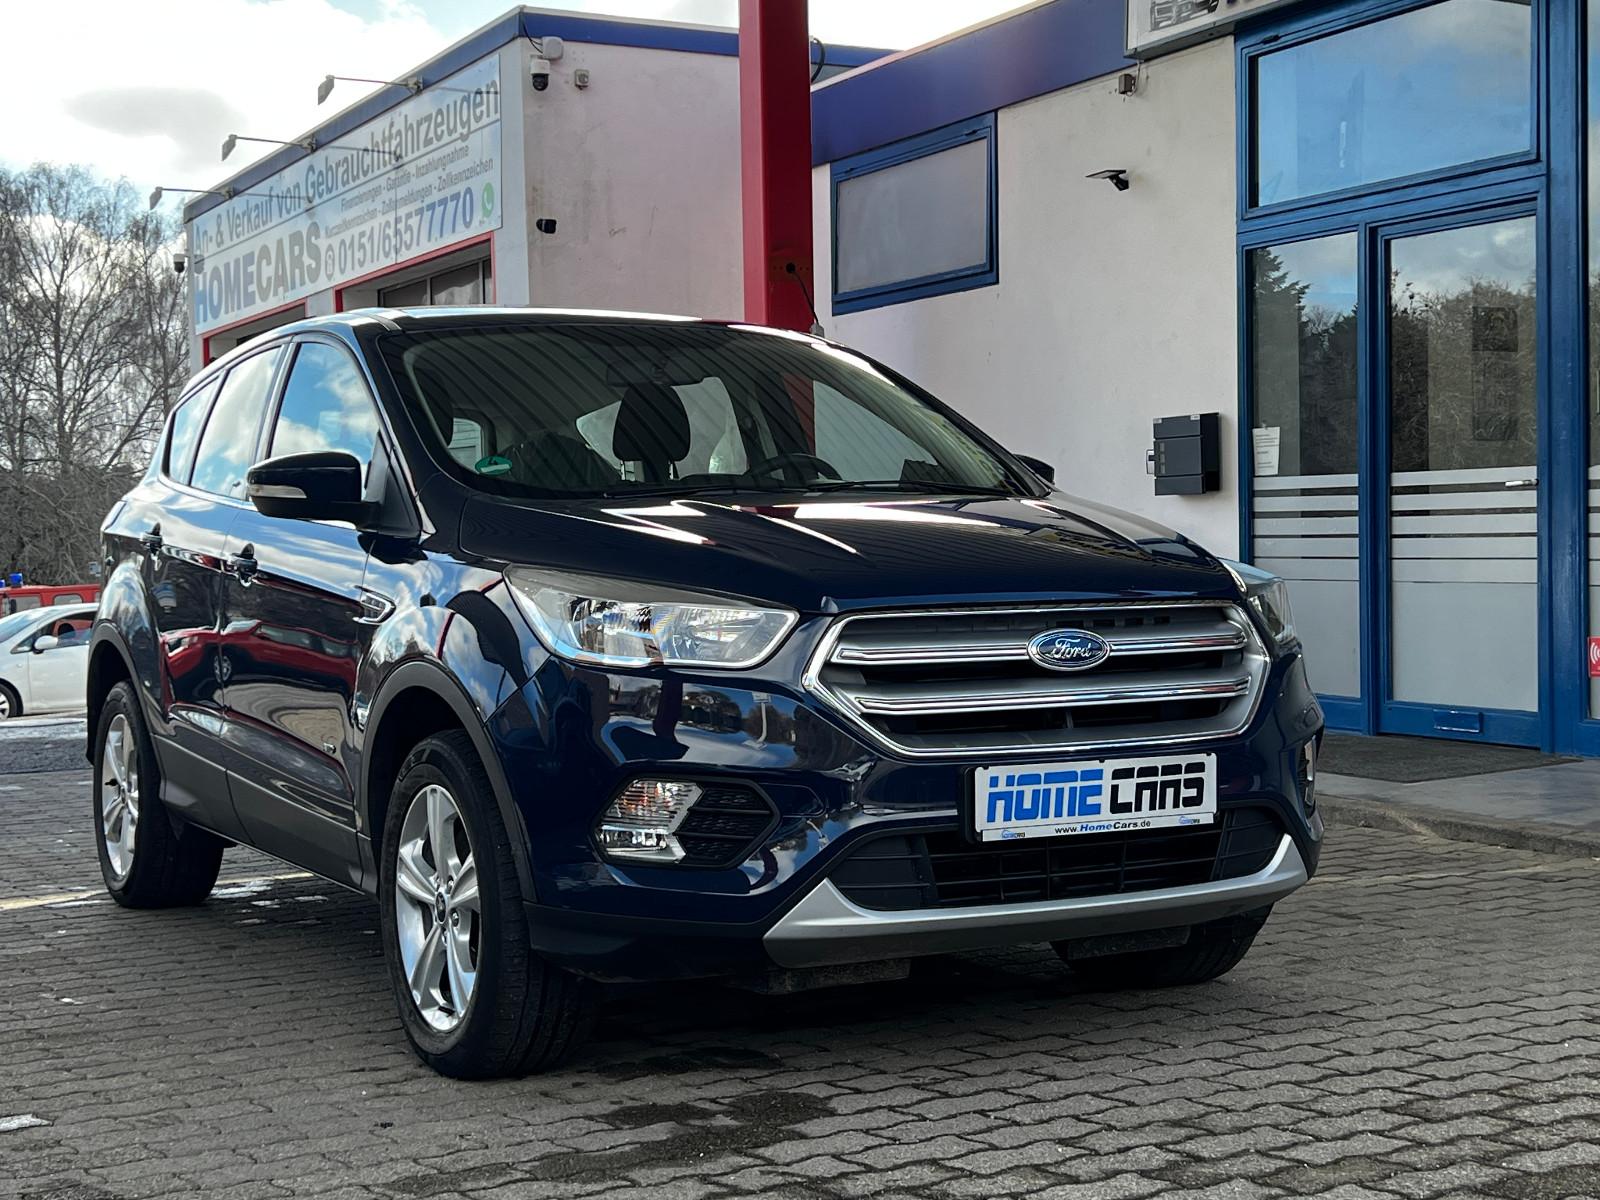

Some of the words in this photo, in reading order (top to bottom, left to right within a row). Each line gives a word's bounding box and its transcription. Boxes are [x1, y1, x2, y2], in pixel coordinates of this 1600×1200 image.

[216, 213, 225, 249] &
[226, 186, 274, 241] Verkauf
[277, 176, 302, 219] von
[304, 78, 499, 203] Gebrauchtfahrzeugen
[338, 186, 474, 276] 0151/65577770
[1048, 638, 1091, 659] Ford
[986, 768, 1104, 823] HOME
[1054, 820, 1151, 834] www.HomeCars.de
